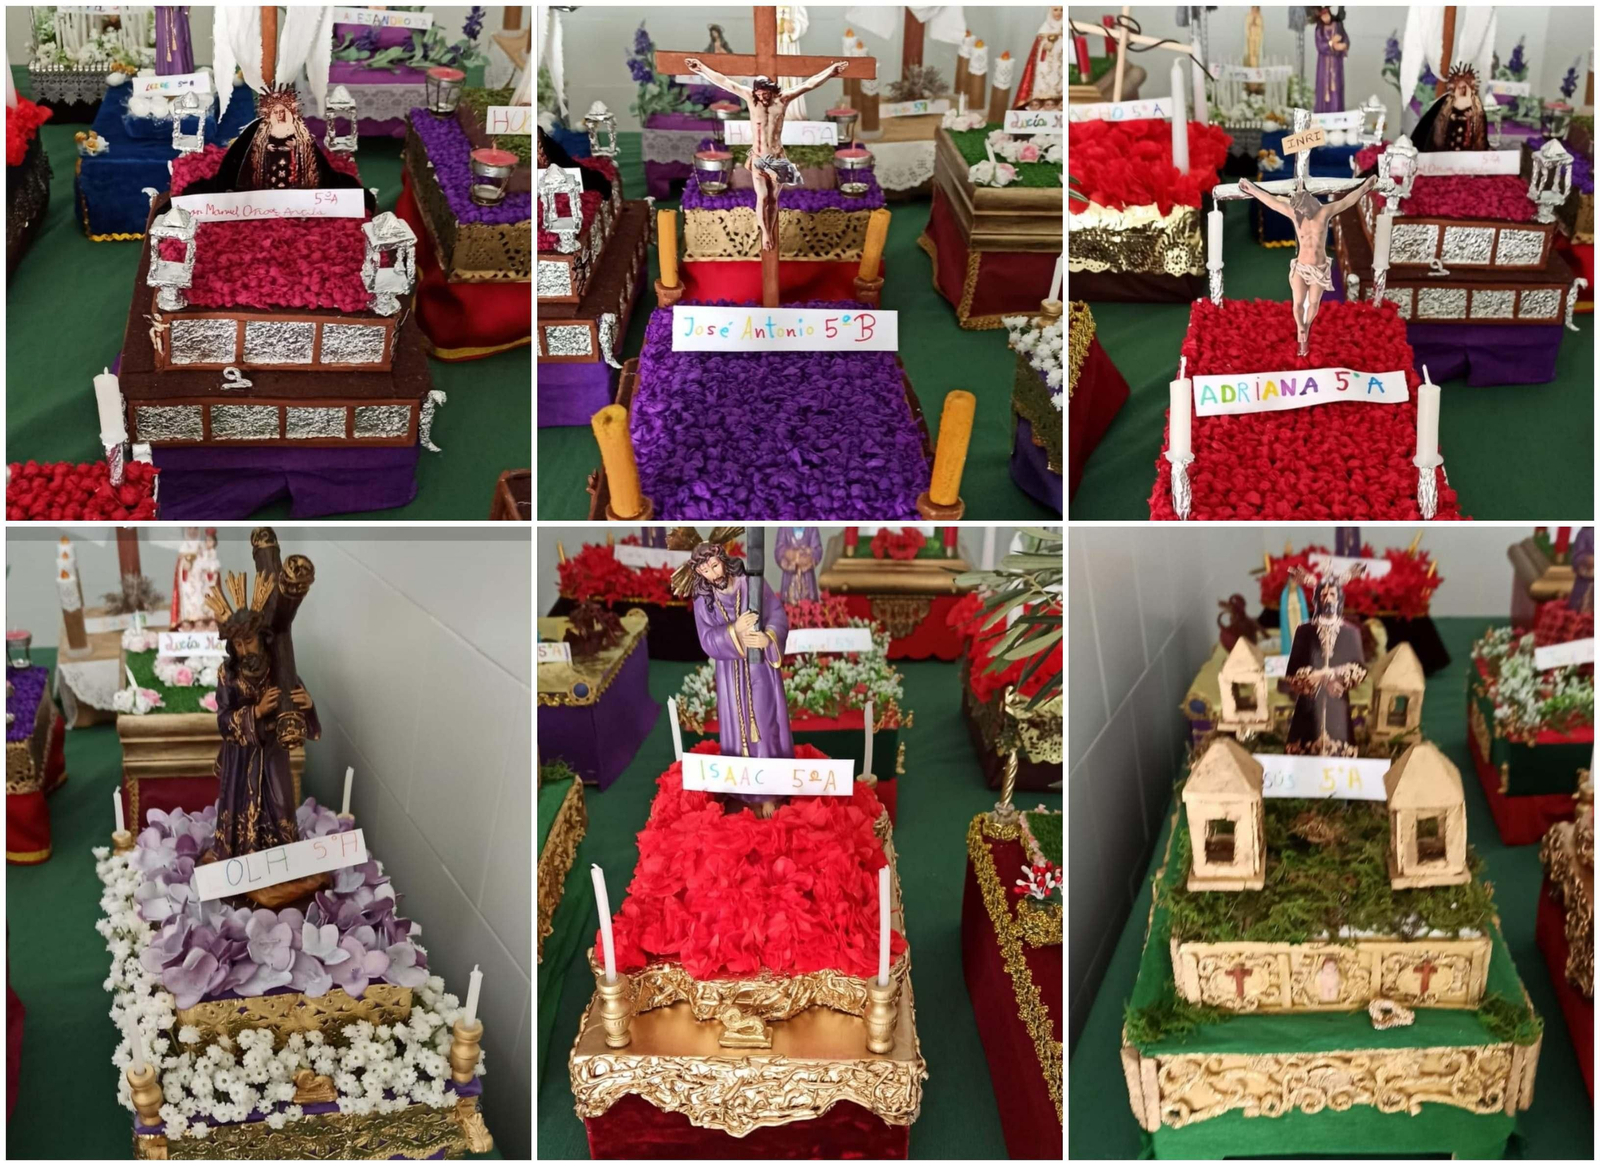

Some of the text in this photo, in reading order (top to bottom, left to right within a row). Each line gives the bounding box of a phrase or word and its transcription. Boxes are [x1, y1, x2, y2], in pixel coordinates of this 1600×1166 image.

[1286, 130, 1322, 149] INRI
[683, 315, 733, 338] José
[741, 314, 815, 340] Antonio
[700, 759, 765, 787] ISAAC
